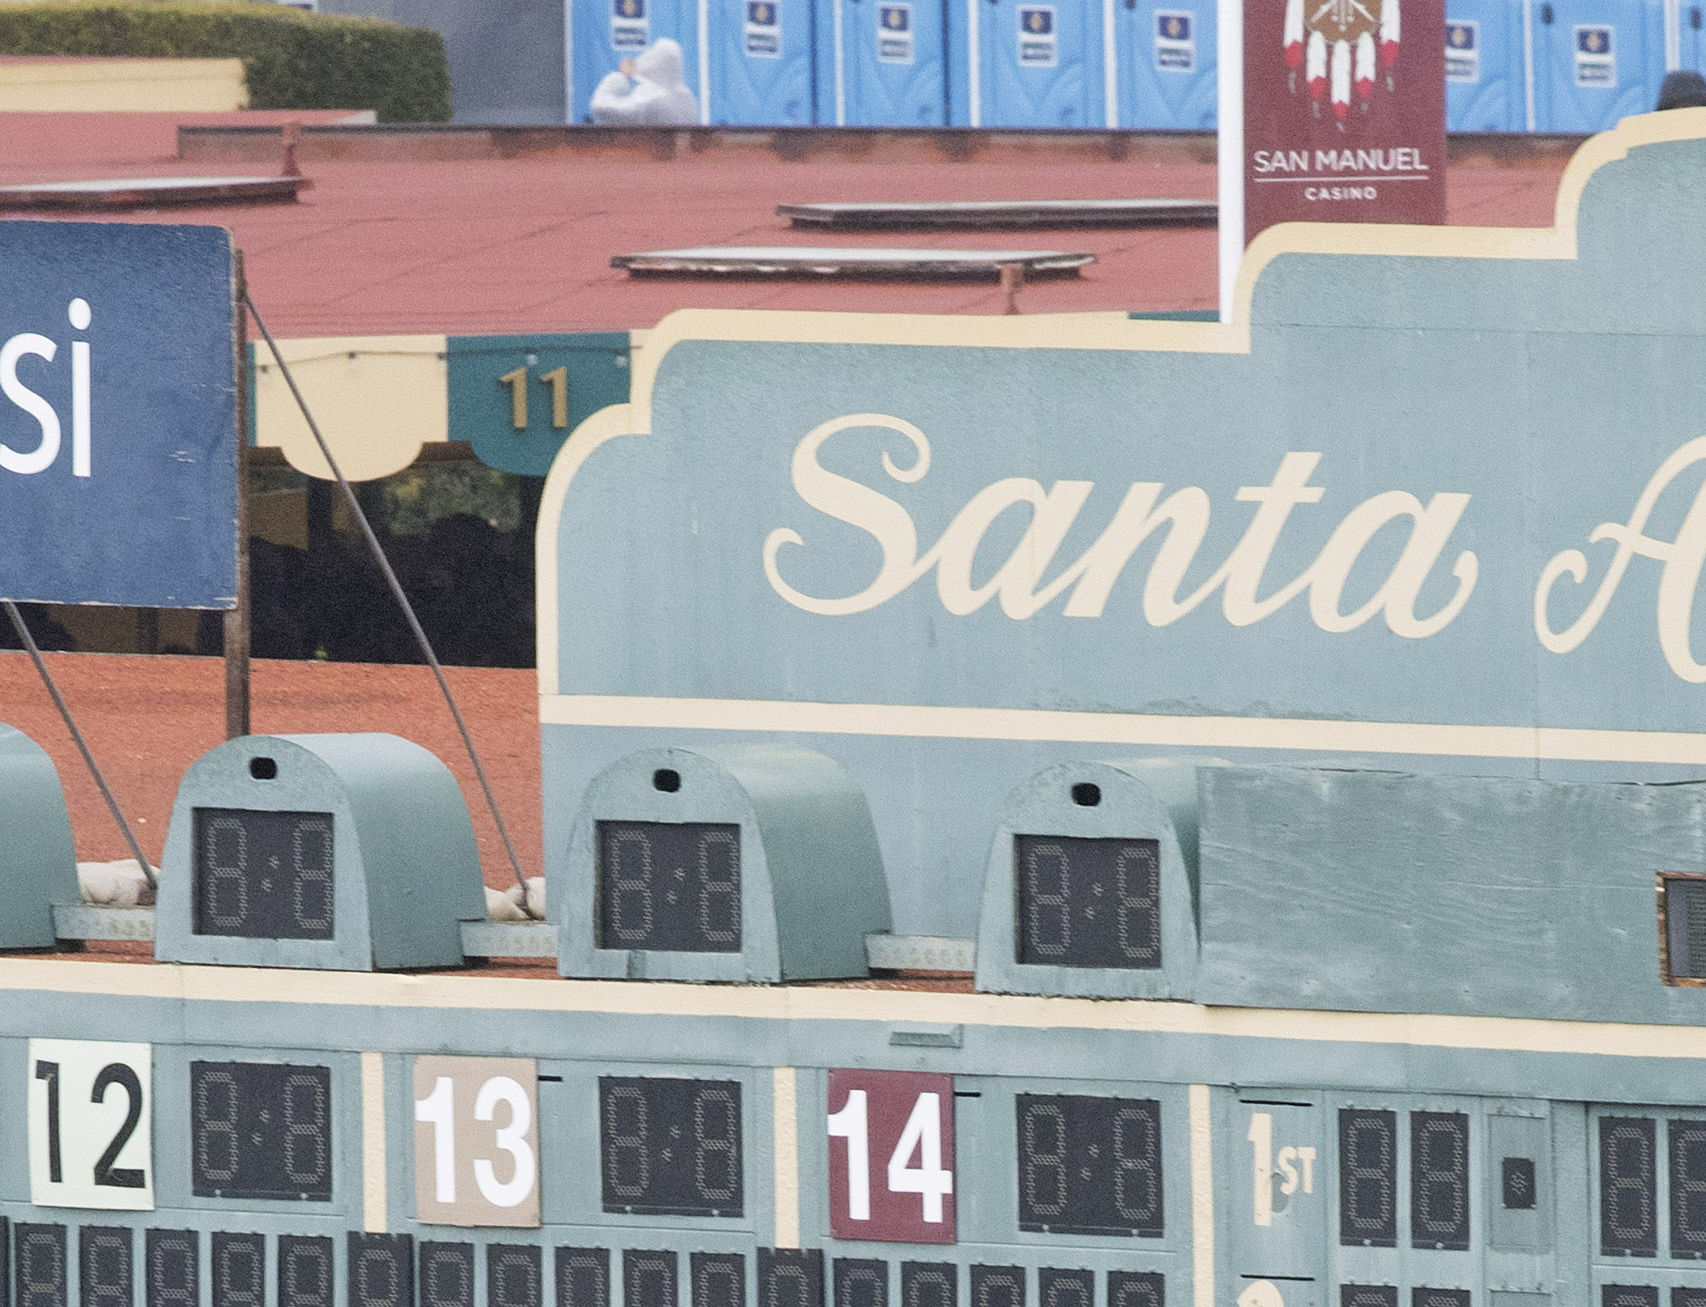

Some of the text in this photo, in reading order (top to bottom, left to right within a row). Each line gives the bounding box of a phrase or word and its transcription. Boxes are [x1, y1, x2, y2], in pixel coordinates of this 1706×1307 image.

[1253, 147, 1429, 172] SAN MANUEL
[1304, 186, 1377, 200] CASINO
[498, 366, 569, 429] 11
[763, 412, 1478, 640] Santa
[34, 1060, 146, 1188] 12
[416, 1075, 536, 1209] 13
[827, 1089, 953, 1224] 14
[1246, 1112, 1317, 1227] 1ST
